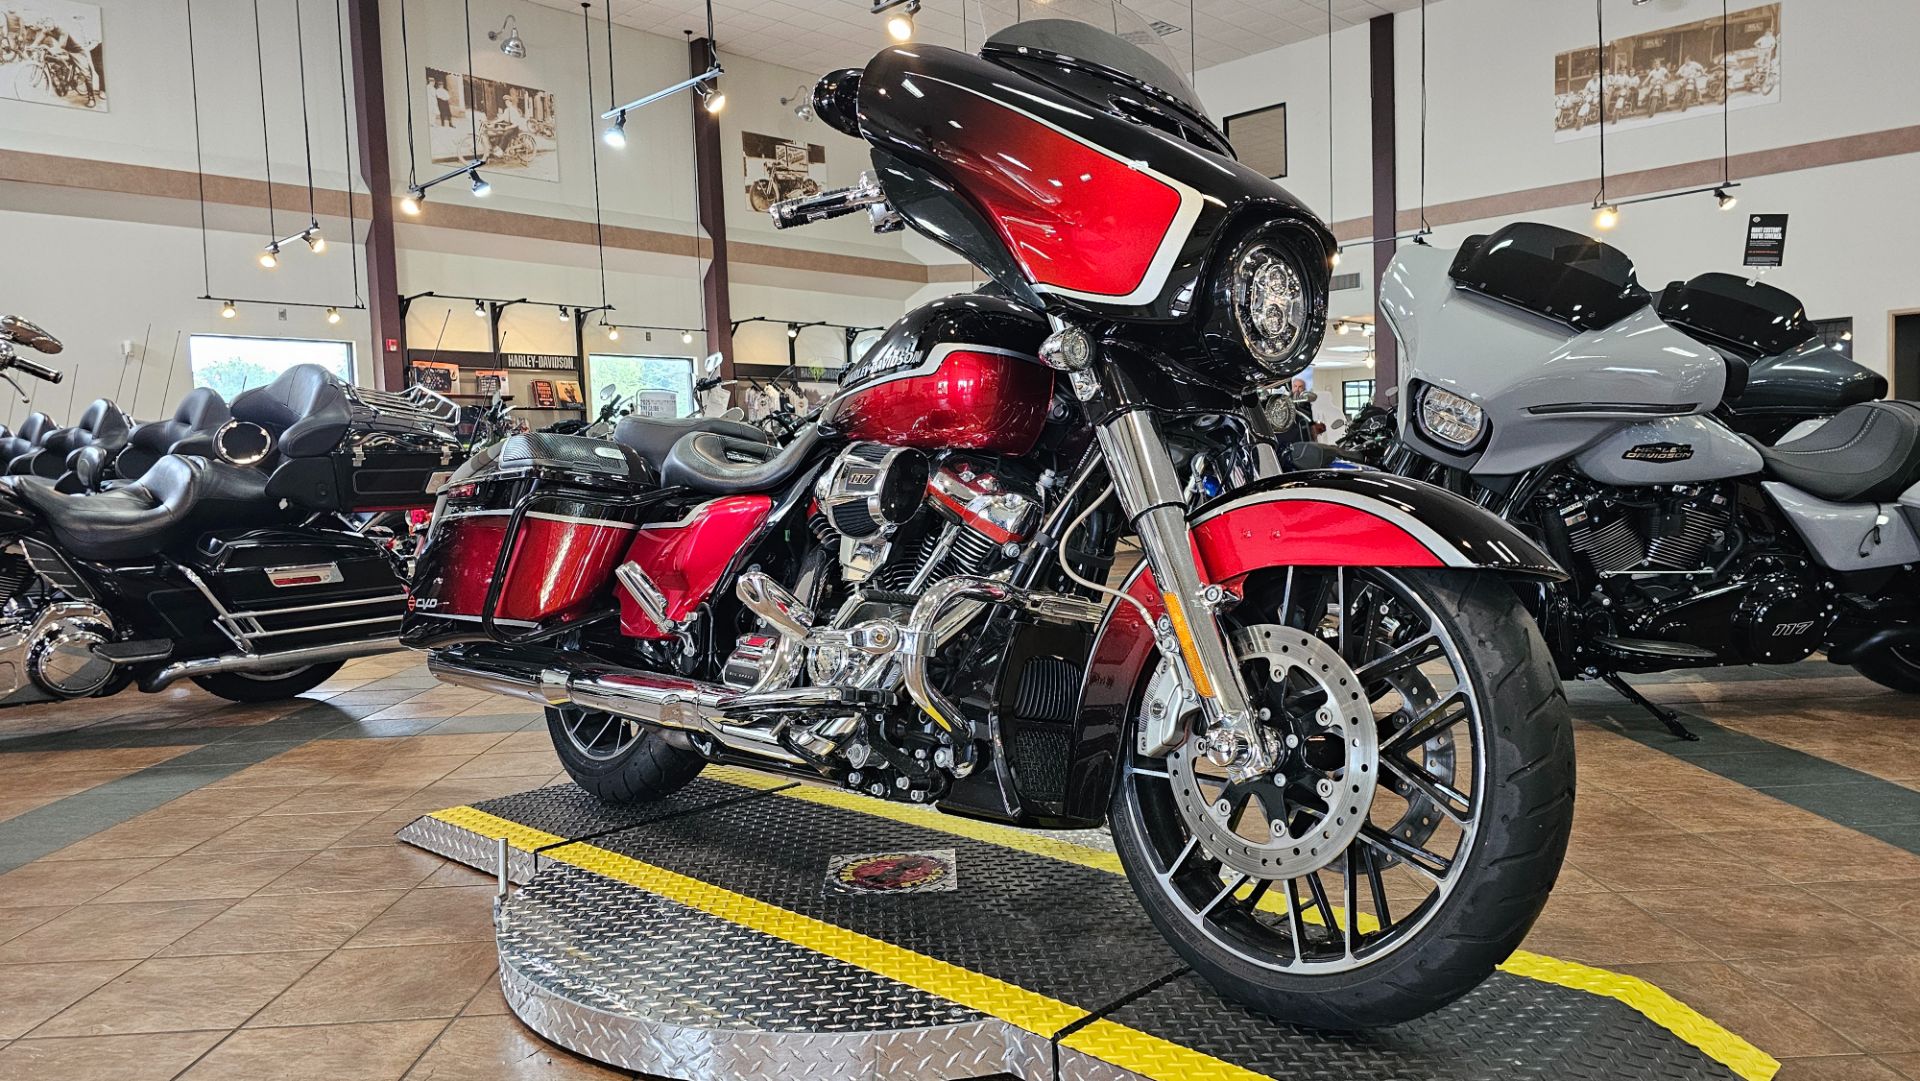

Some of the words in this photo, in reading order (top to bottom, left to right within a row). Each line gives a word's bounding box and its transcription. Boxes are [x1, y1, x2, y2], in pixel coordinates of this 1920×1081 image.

[507, 354, 574, 369] HARLEY-DAVIDSON
[848, 473, 876, 485] 117
[1771, 620, 1815, 636] 117
